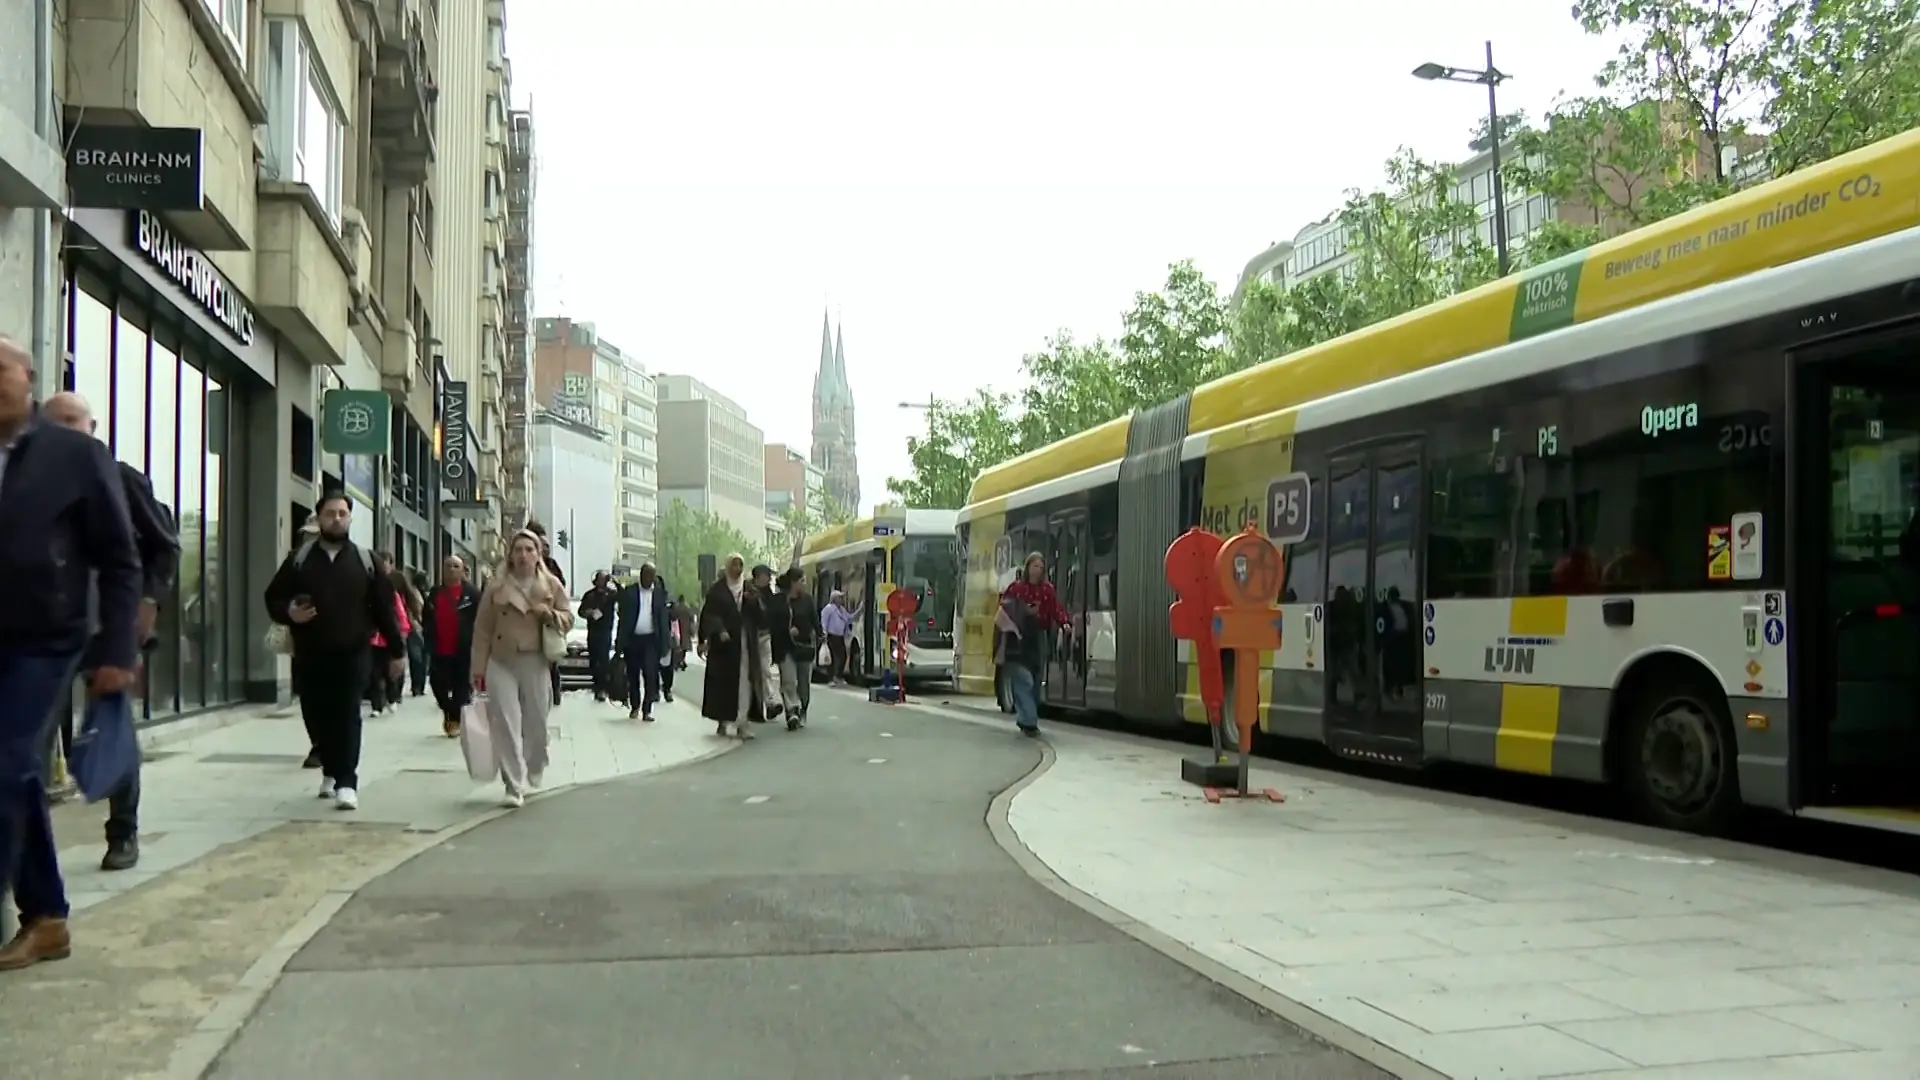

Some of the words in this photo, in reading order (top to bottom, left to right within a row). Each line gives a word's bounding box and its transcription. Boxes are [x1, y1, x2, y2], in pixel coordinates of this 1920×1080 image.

[76, 149, 191, 168] BRAIN-NM
[106, 172, 161, 184] CLINICS
[1605, 249, 1662, 280] Beweeg
[1667, 235, 1701, 259] mee
[1707, 218, 1750, 247] naar
[1756, 190, 1831, 231] minder
[139, 209, 211, 309] BRAIN-NM
[213, 278, 255, 347] CLINICS
[1525, 272, 1568, 303] 100%
[1522, 295, 1566, 318] elektrisch
[446, 388, 463, 478] JAMINGO
[1641, 402, 1698, 438] Opera
[1538, 426, 1557, 458] P5
[1202, 505, 1231, 533] Met
[1238, 496, 1259, 531] de
[1273, 490, 1299, 528] P5
[1426, 694, 1446, 710] 2977
